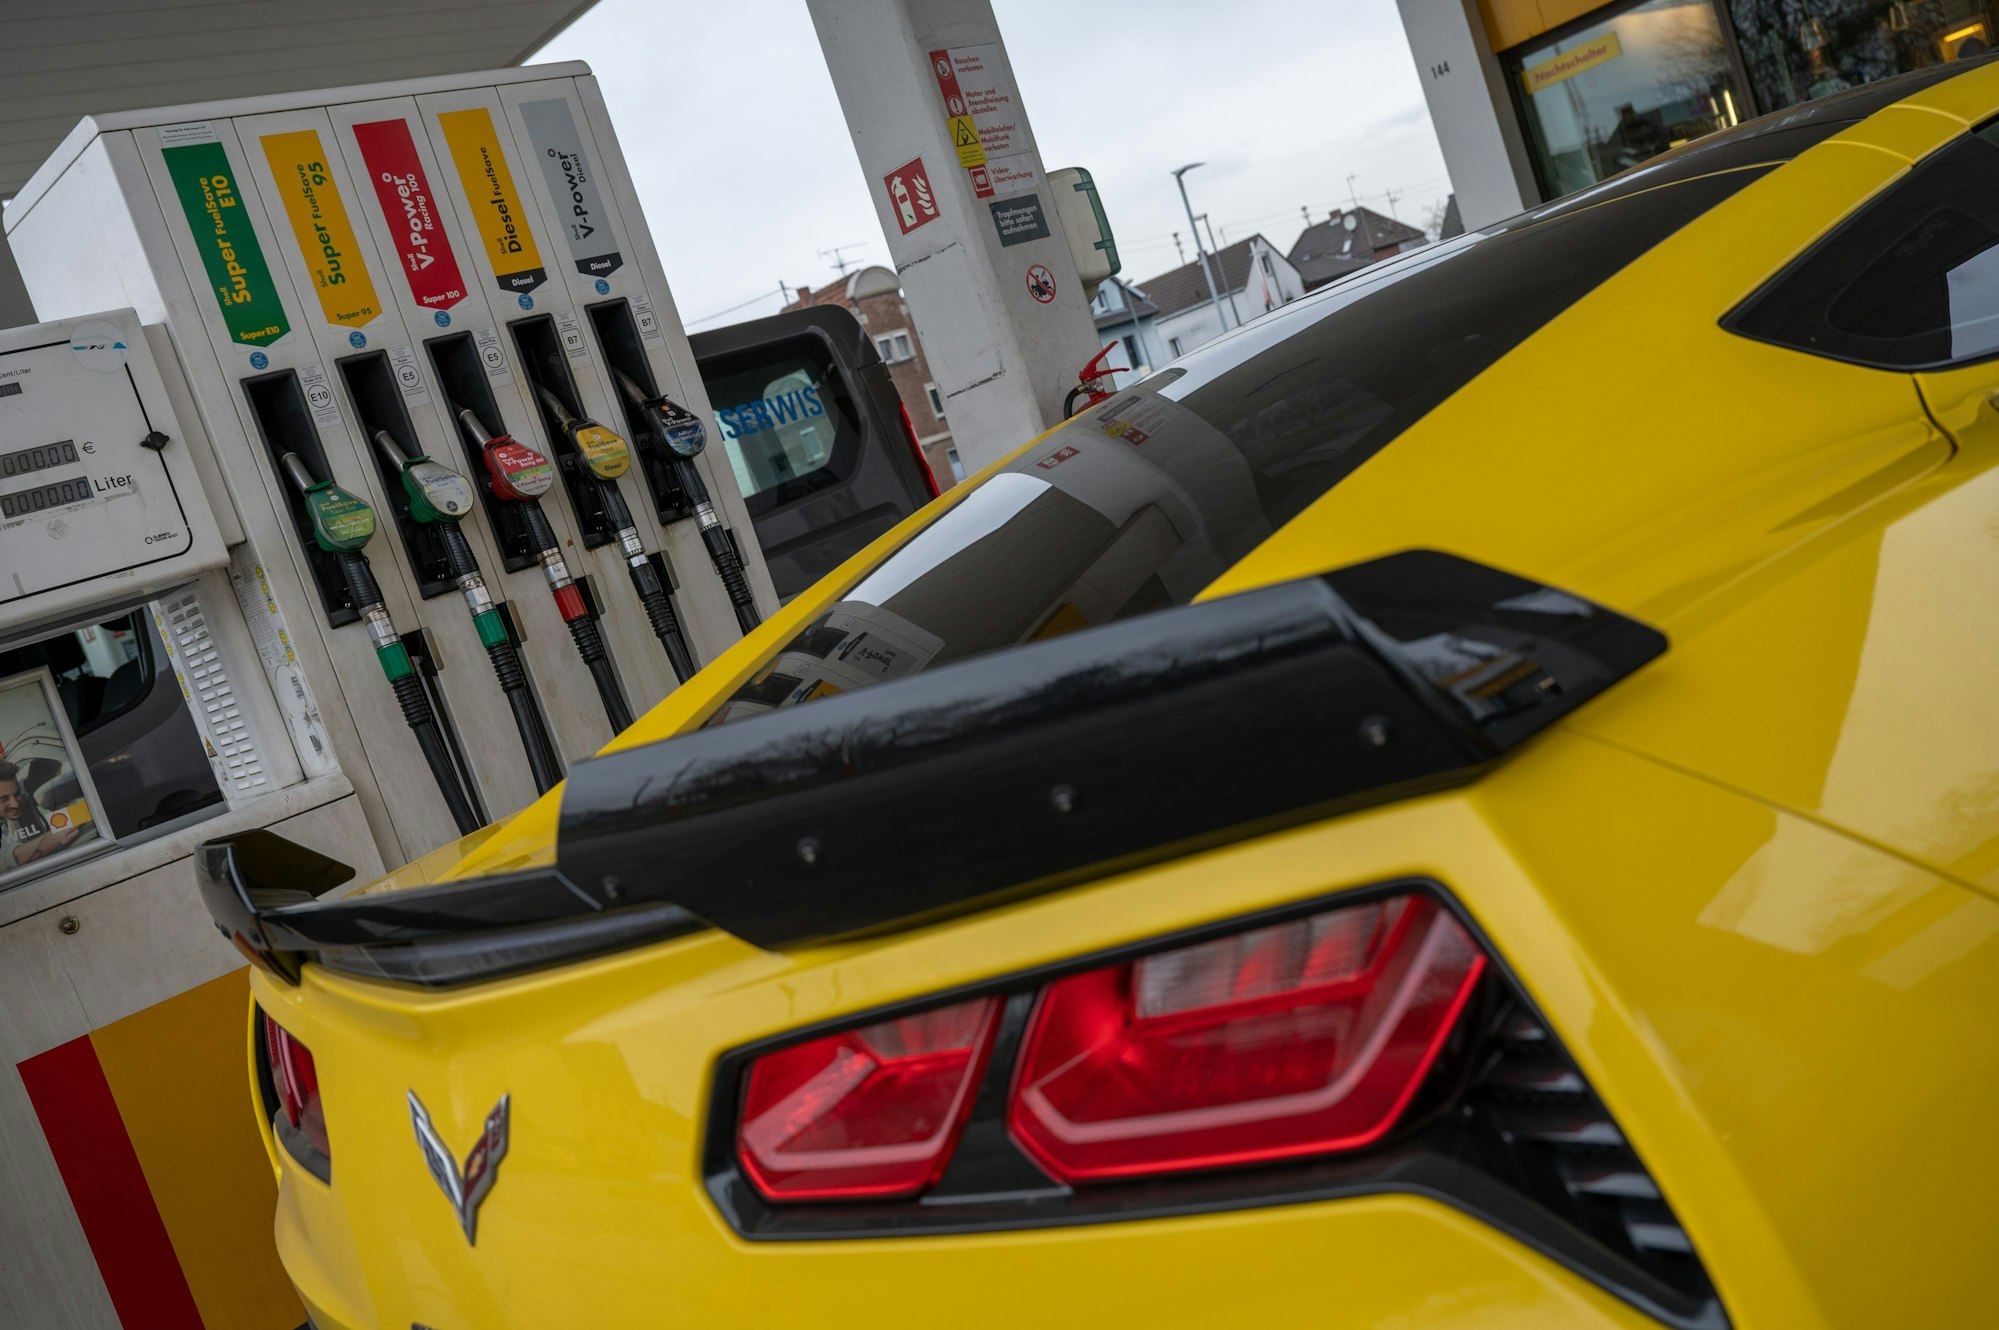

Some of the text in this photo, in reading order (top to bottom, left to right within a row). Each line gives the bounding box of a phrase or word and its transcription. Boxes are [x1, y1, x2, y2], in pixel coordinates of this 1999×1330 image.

[955, 57, 979, 65] Rauchen
[1535, 45, 1608, 83] Nachtschalter
[958, 64, 984, 73] verboten
[1431, 61, 1450, 80] 144
[966, 88, 996, 98] Motor und
[971, 106, 997, 115] abstellen
[981, 134, 1010, 144] Mobilfunk
[984, 143, 1010, 152] verboten
[307, 161, 327, 186] 95
[570, 153, 587, 183] Diesel
[994, 171, 1033, 184] überwachung
[211, 175, 237, 207] E10
[557, 151, 595, 241] Shell V-Power
[406, 173, 434, 230] Racing 100
[480, 147, 522, 254] Shell Diesel FuelSave
[996, 205, 1038, 218] Tropfmengen
[296, 164, 346, 288] Shell Super FuelSave
[392, 175, 435, 271] Shell V-Power
[1000, 214, 1034, 227] bitte sofort
[1002, 223, 1038, 235] aufnehmen
[200, 177, 252, 306] Shell Super FuelSave
[590, 260, 611, 271] Diesel
[511, 275, 535, 287] Diesel
[423, 289, 460, 304] Super 100
[337, 306, 372, 322] Super 95
[642, 318, 652, 327] B7
[240, 325, 280, 341] Super E10
[567, 335, 578, 345] B7
[487, 352, 499, 362] E5
[402, 371, 415, 381] E5
[310, 391, 329, 402] E10
[716, 385, 824, 441] SERWIS
[82, 441, 96, 454] €
[94, 473, 133, 492] Liter
[17, 824, 41, 840] ELL
